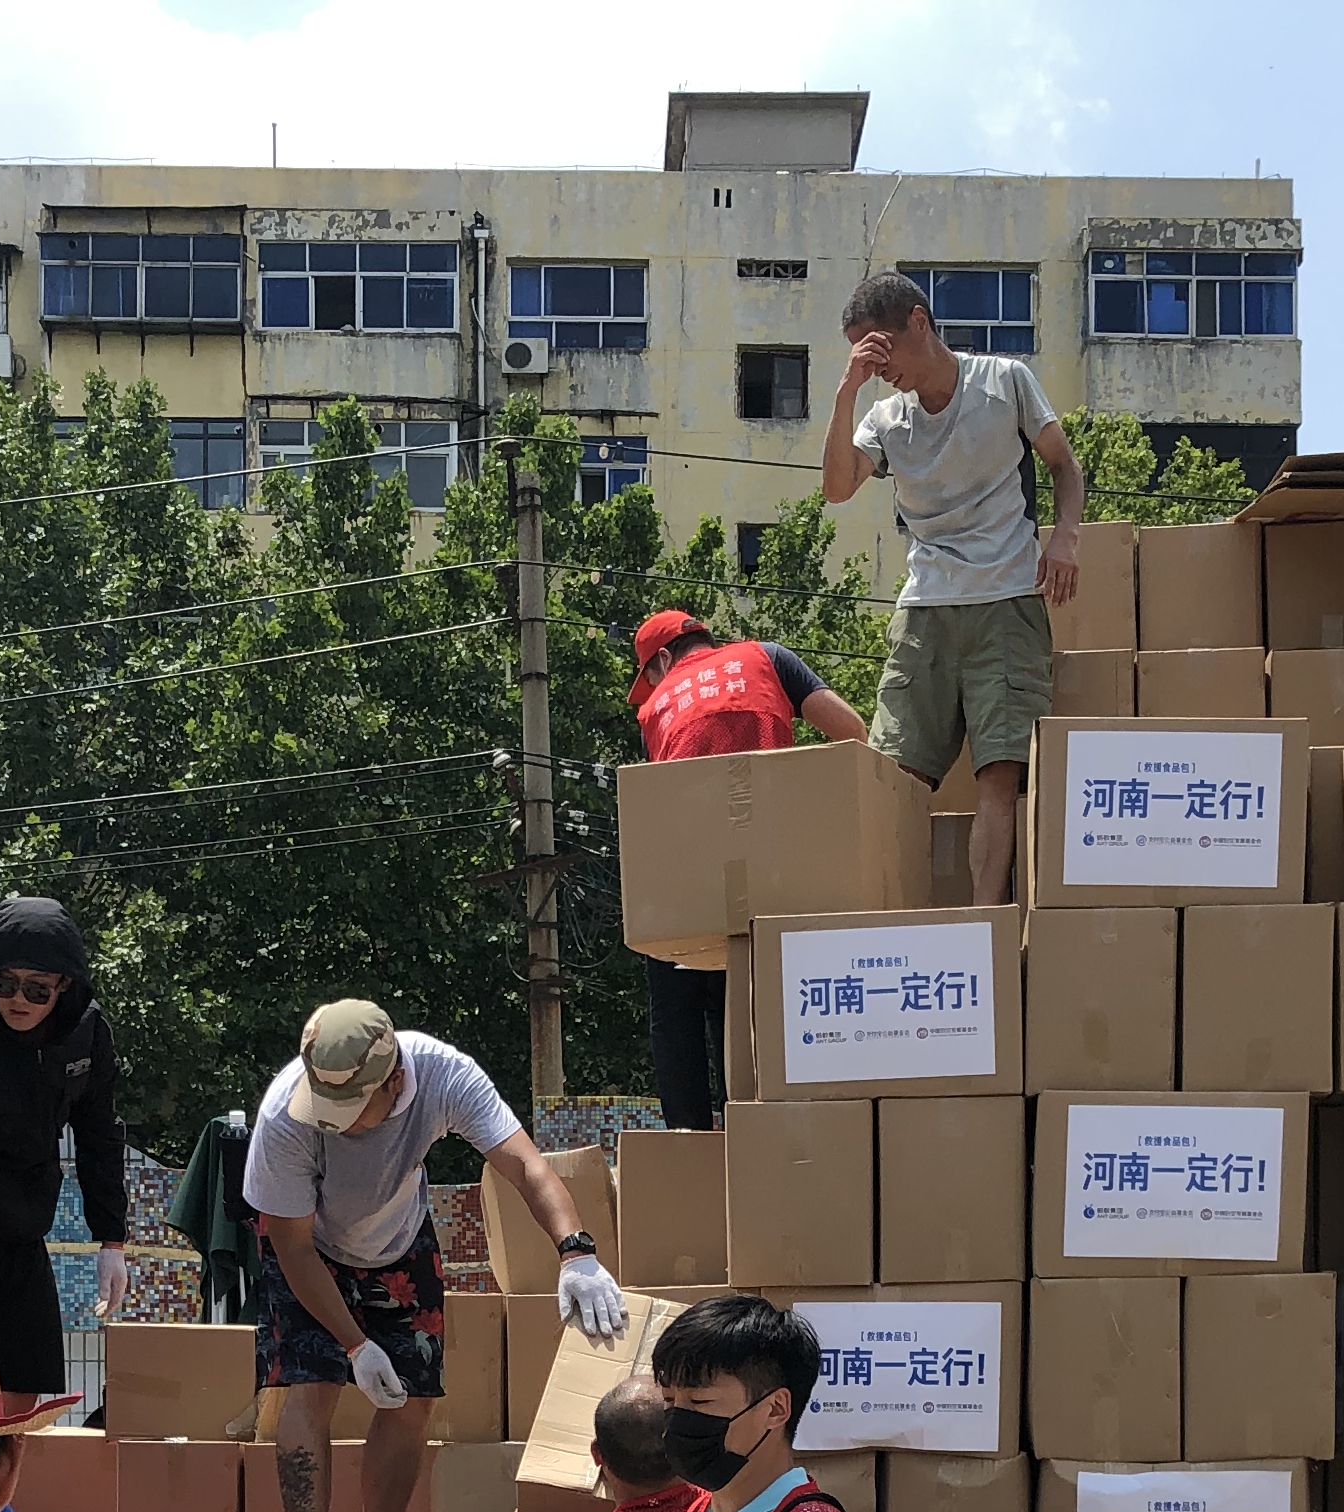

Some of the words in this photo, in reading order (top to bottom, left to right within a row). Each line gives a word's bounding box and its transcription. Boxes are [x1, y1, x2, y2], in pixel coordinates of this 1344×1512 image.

[1081, 777, 1265, 820] 河南一定行!
[798, 969, 978, 1017] 河南一定行!
[1082, 1150, 1266, 1193] 河南一定行!
